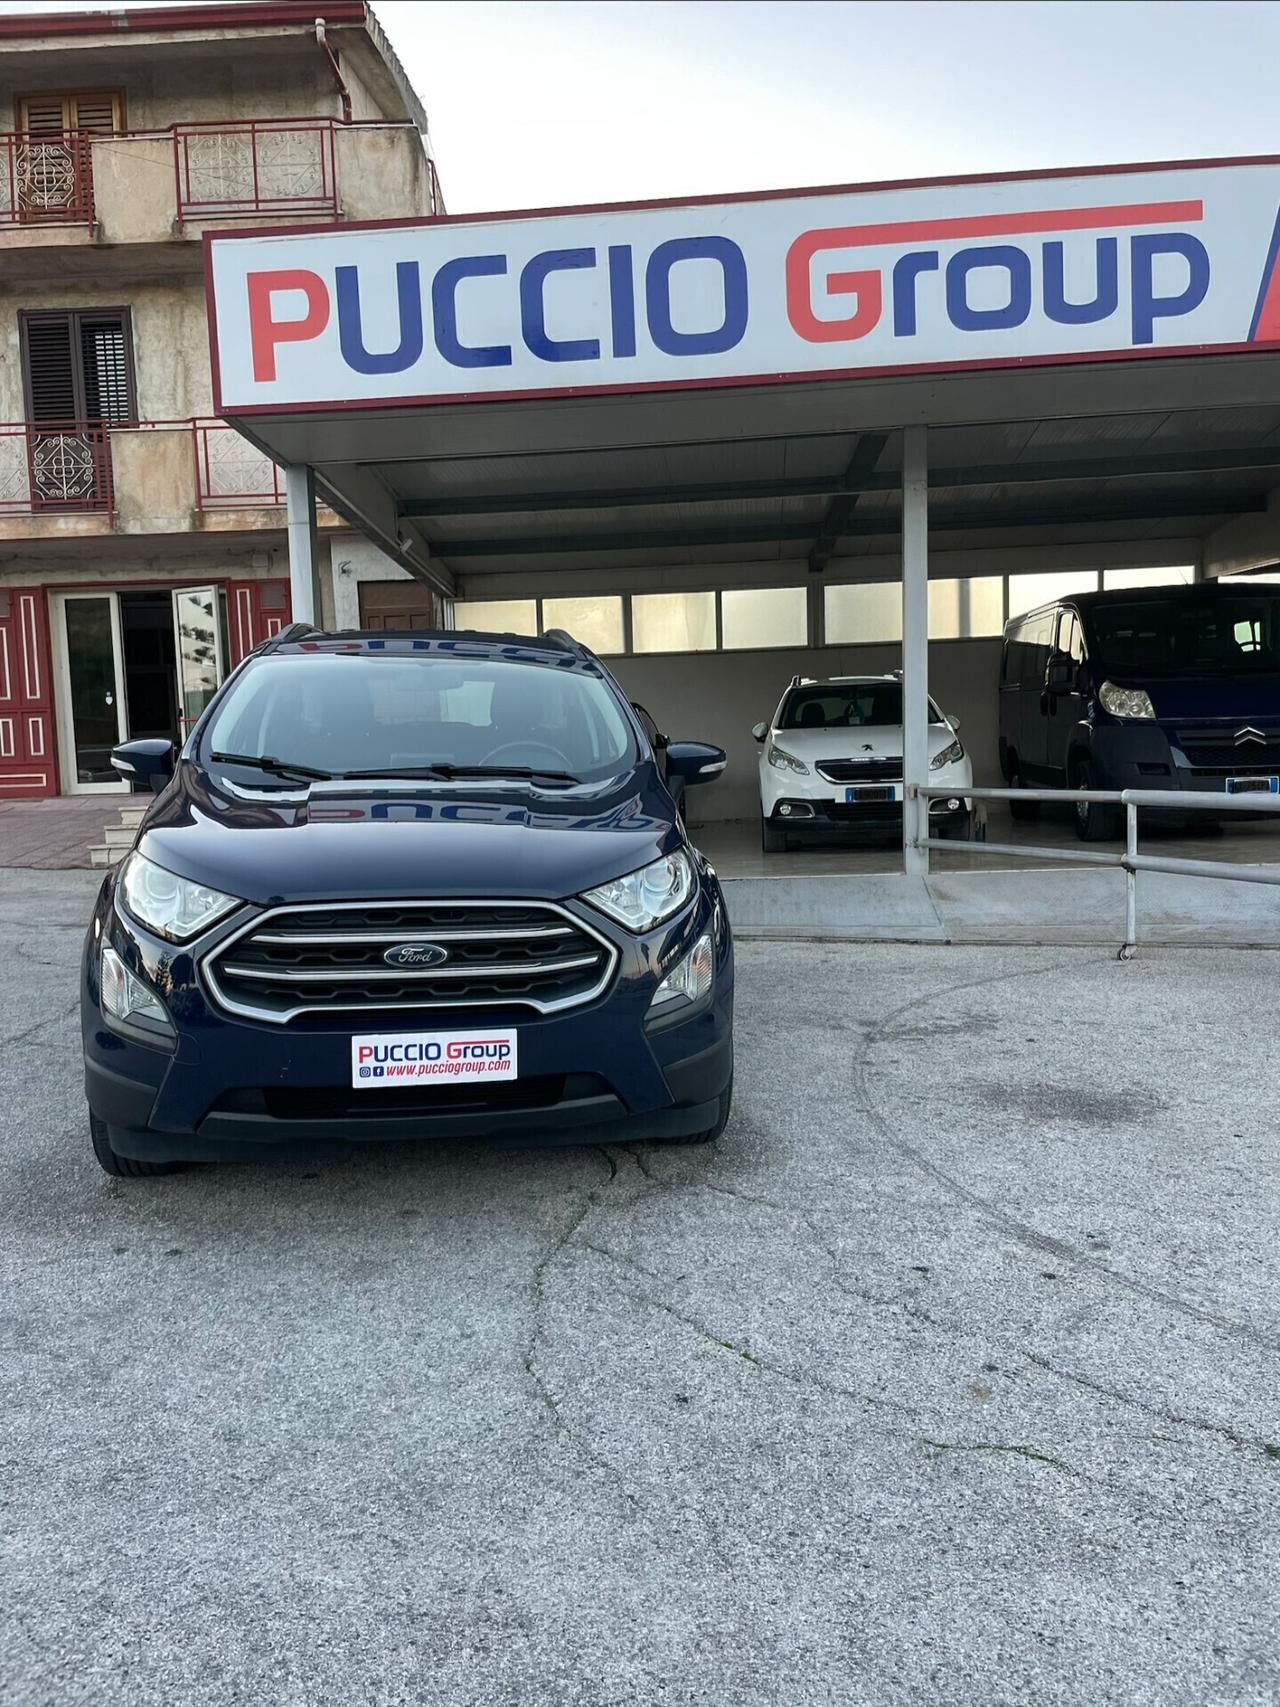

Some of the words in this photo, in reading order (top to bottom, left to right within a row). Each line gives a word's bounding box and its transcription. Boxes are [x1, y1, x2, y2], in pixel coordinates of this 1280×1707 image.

[247, 235, 749, 381] PUCCIO
[786, 200, 1212, 346] Group
[398, 947, 433, 963] Ford
[358, 1042, 441, 1064] PUCCIO
[446, 1039, 511, 1060] Group
[386, 1059, 511, 1077] www.pucciogroup.com
